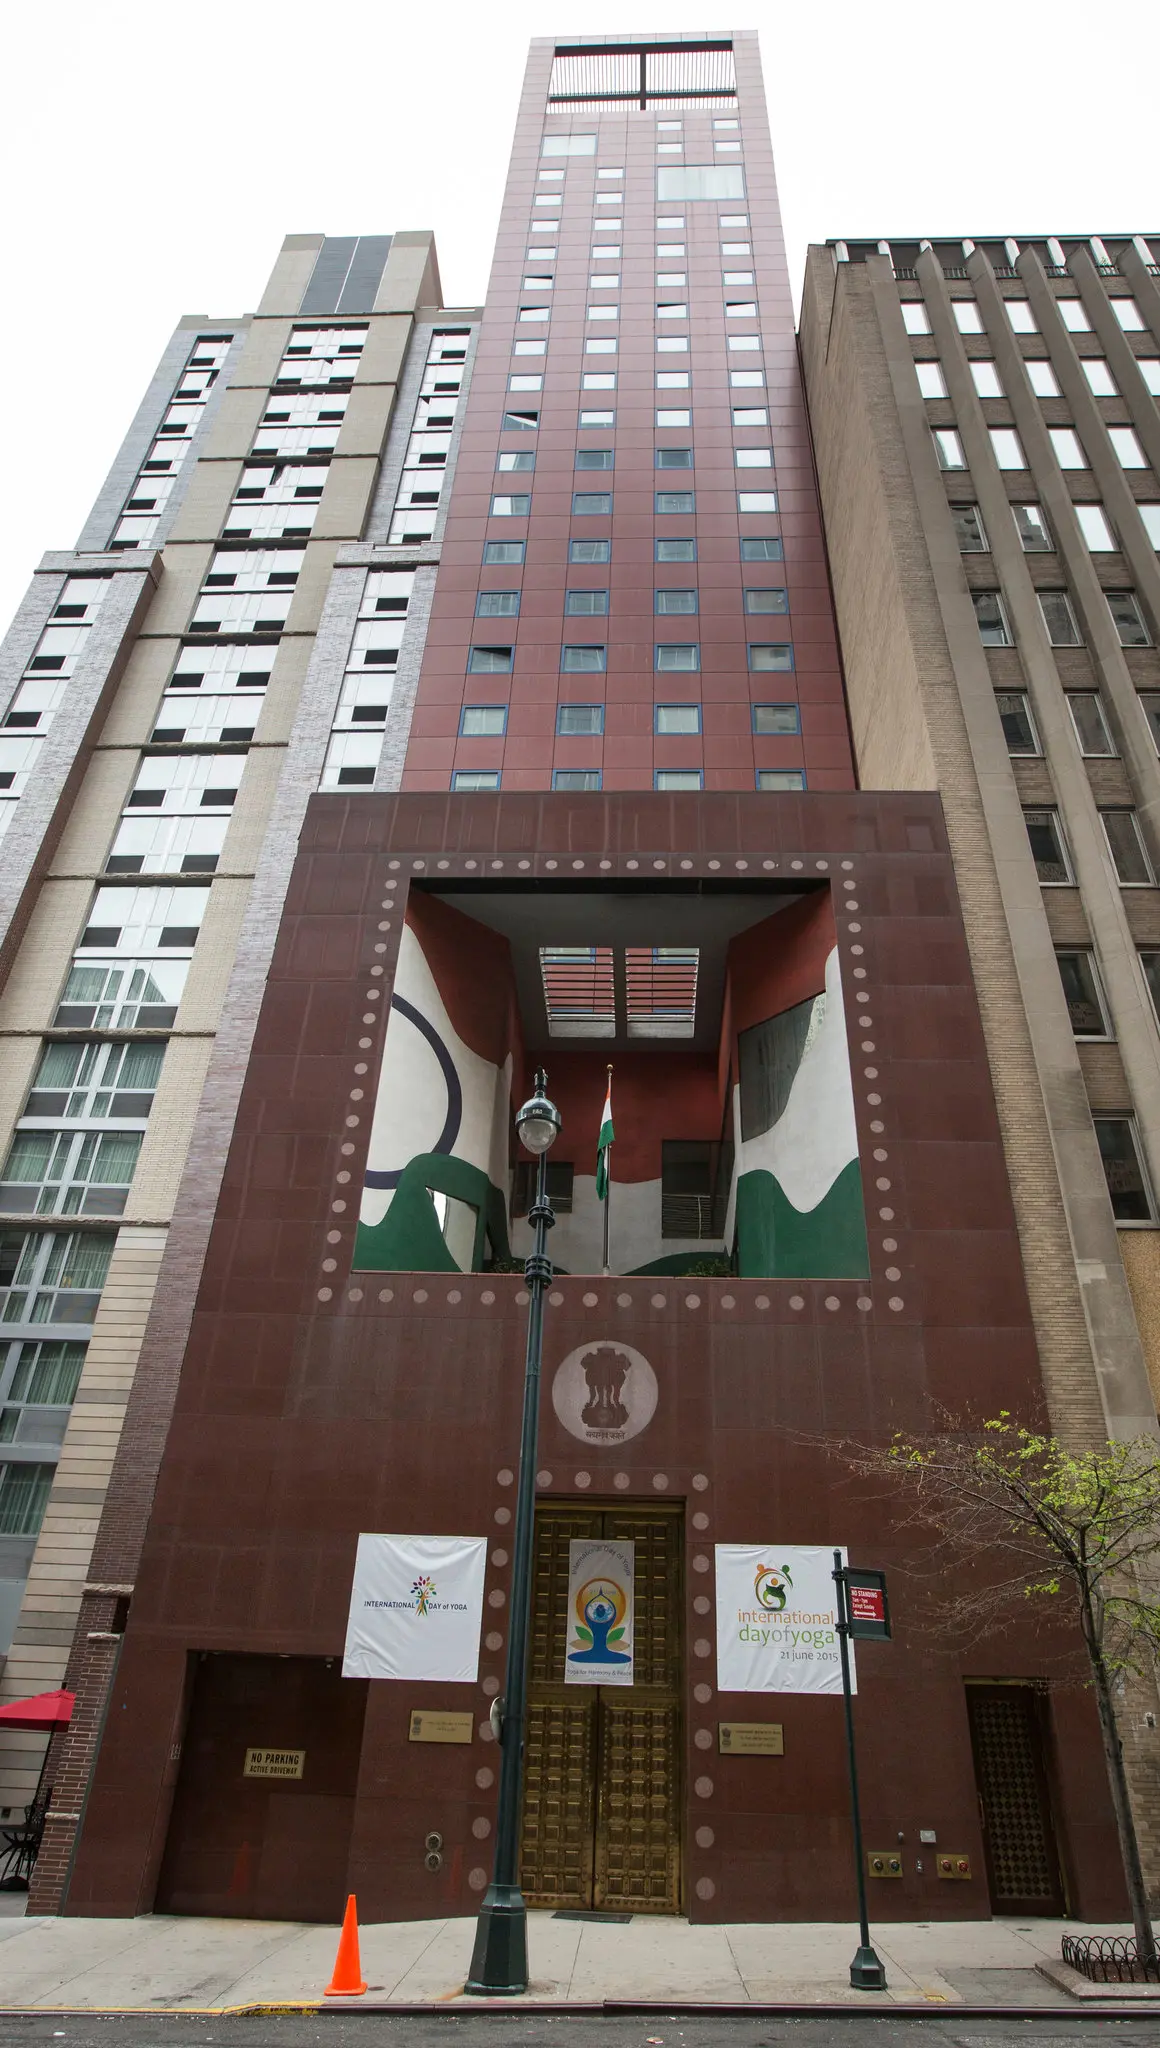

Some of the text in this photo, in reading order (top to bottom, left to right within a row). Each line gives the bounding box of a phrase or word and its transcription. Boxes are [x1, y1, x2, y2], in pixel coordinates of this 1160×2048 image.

[603, 1545, 616, 1556] Day
[616, 1552, 625, 1560] of
[858, 1590, 878, 1598] STANDING
[363, 1600, 416, 1609] INTERNATIONAL
[428, 1602, 441, 1610] DAY
[451, 1603, 468, 1611] YOGA
[738, 1609, 834, 1624] international
[780, 1649, 839, 1663] 21 june 2015
[251, 1752, 300, 1765] NO PARKING
[249, 1765, 298, 1775] ACTIVE DRIVEWAY
